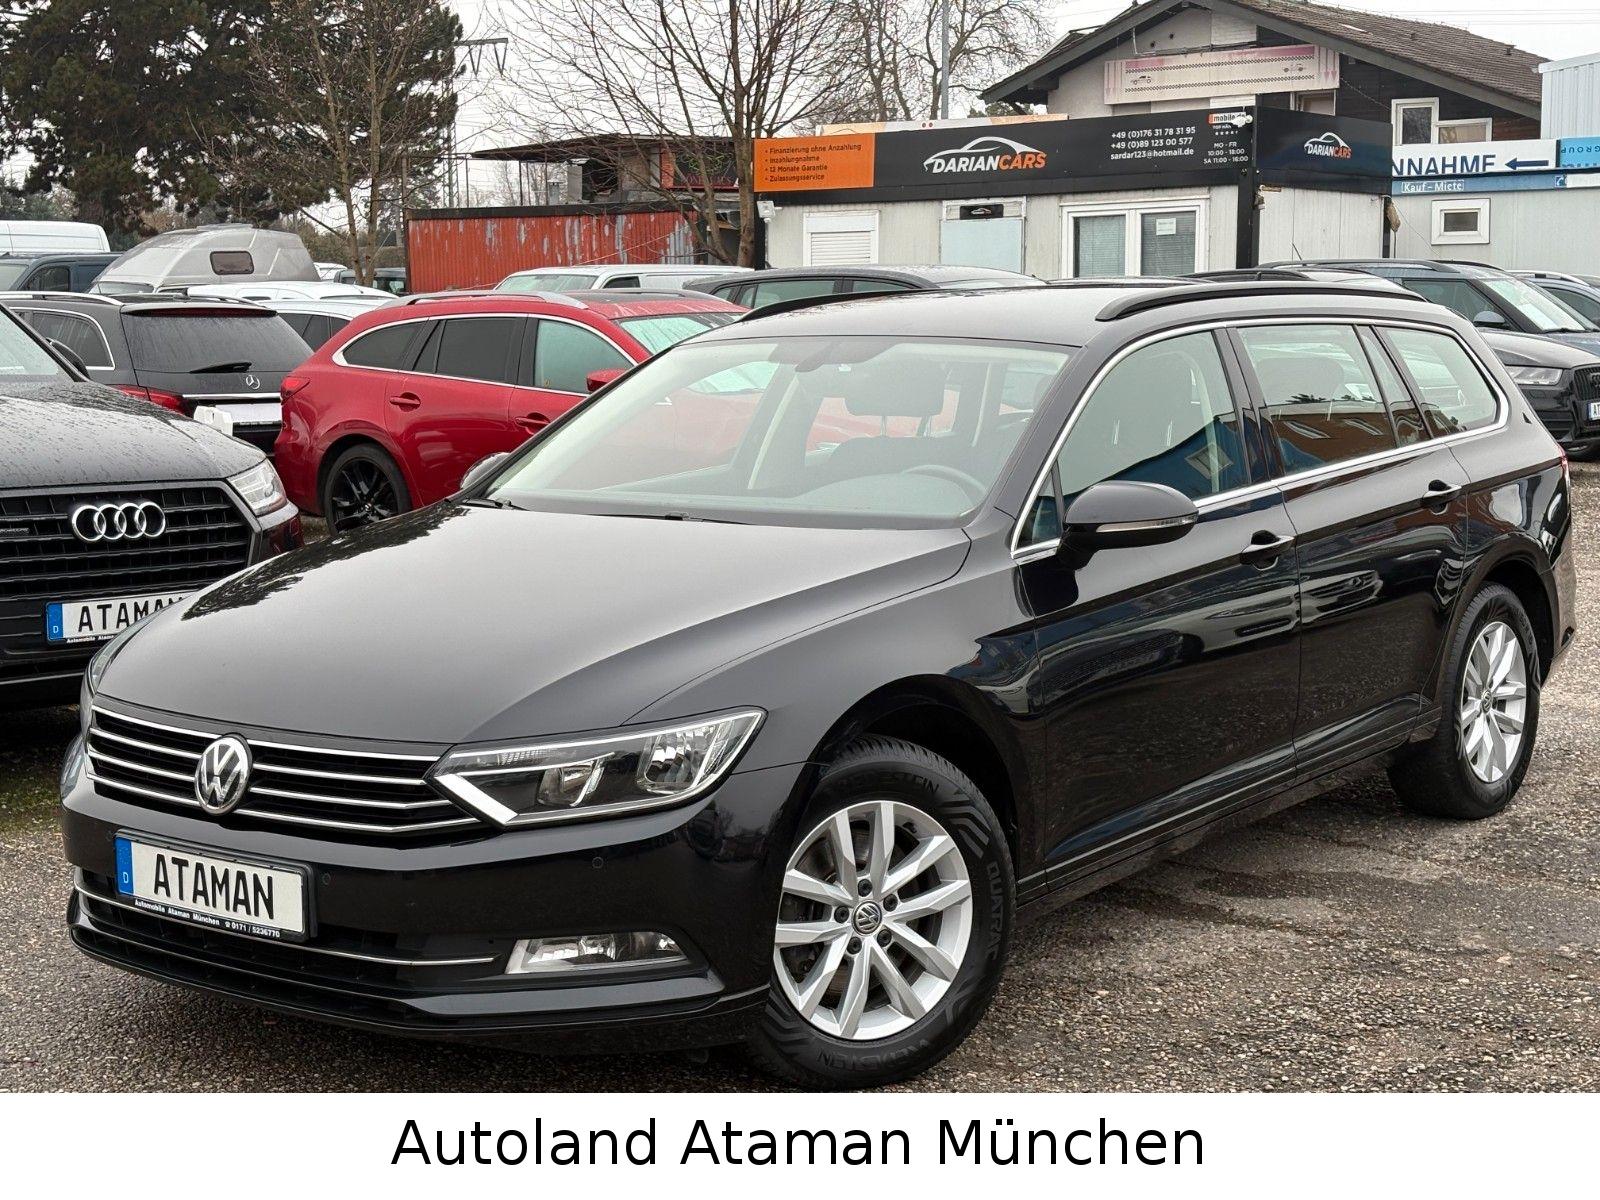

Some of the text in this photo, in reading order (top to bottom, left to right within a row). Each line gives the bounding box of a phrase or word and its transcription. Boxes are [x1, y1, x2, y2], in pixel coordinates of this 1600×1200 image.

[1112, 126, 1196, 139] +49 (0)176 31 78 31 95
[828, 144, 862, 152] Anzahlung
[1111, 137, 1193, 149] +49 (0)89 123 00 577
[1110, 148, 1194, 160] sardar123@hotmail.de
[1307, 143, 1352, 159] DARIANCARS
[932, 151, 1047, 174] DARIANCARS
[769, 174, 824, 182] Zulassungsservice
[1404, 182, 1426, 192] Kauf
[1434, 180, 1463, 191] Miete
[52, 625, 59, 634] D
[122, 871, 130, 884] D
[153, 853, 275, 920] ATAMAN
[134, 899, 166, 914] Automobile
[168, 906, 191, 920] Ataman
[192, 912, 220, 926] München
[231, 922, 247, 932] 0171
[252, 925, 280, 939] 5236770
